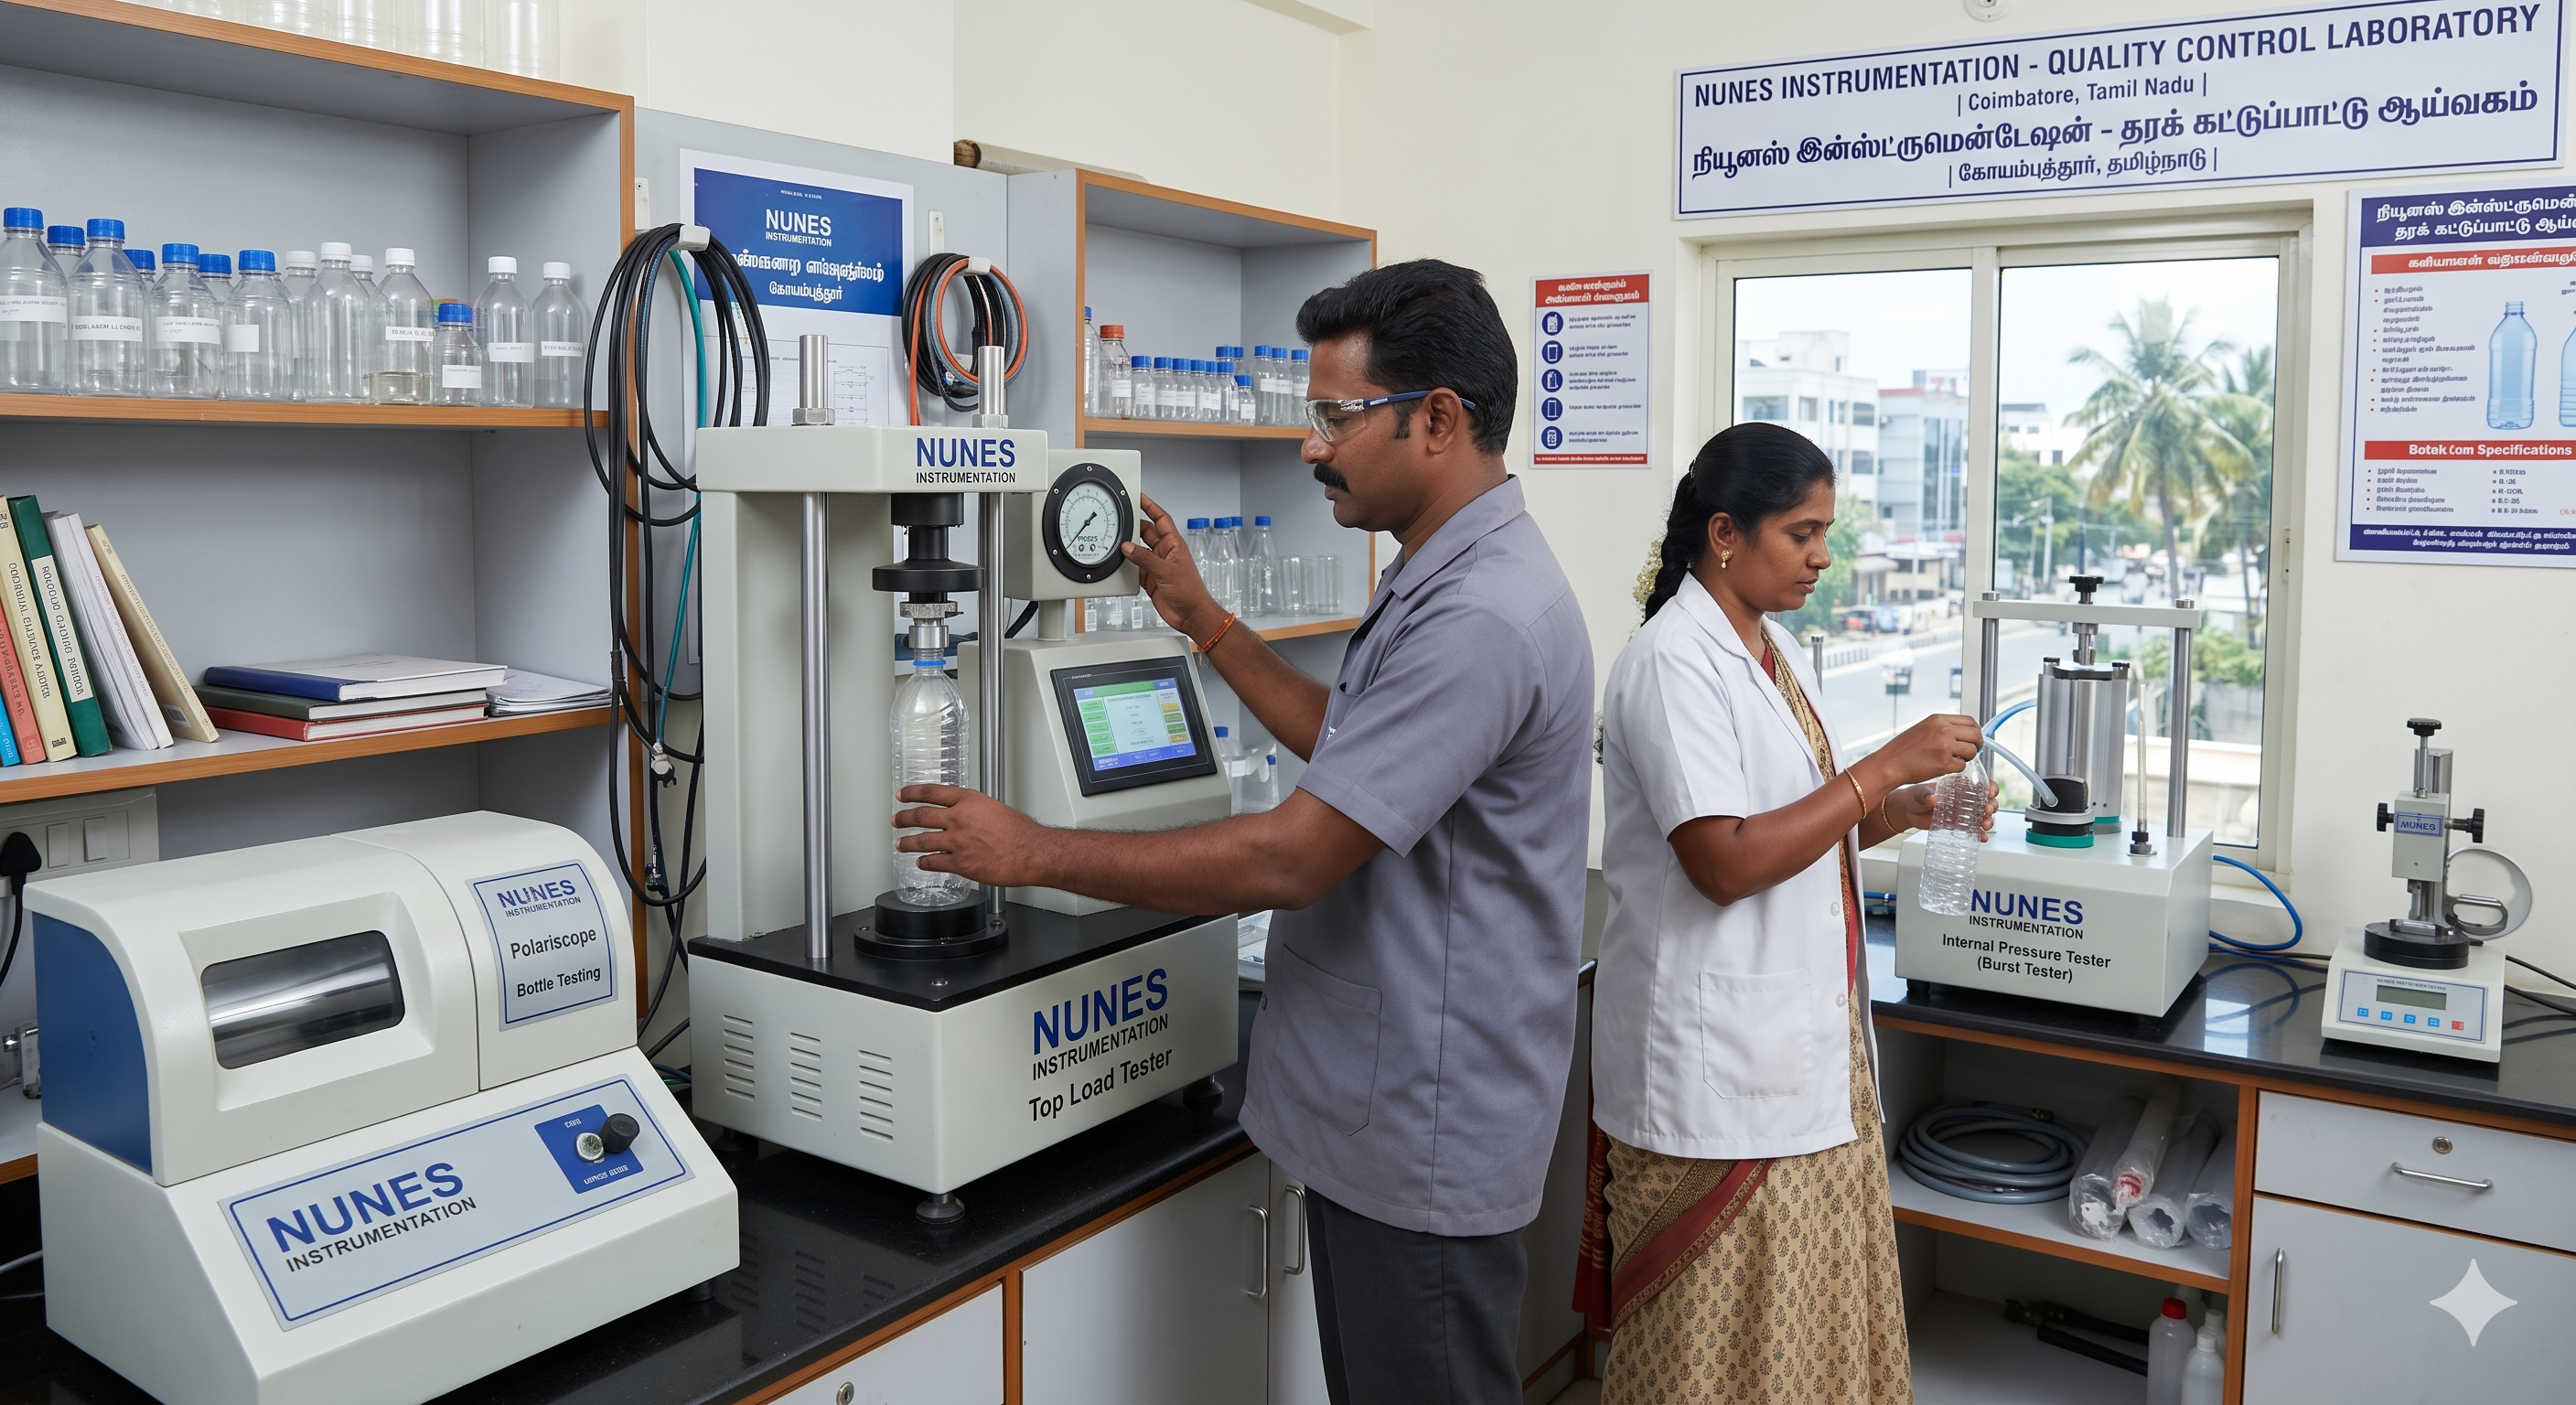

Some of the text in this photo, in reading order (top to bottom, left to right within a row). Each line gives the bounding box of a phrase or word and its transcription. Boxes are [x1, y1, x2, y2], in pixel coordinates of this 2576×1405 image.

[1694, 79, 1773, 107] NUNES
[1781, 54, 2020, 99] INSTRUMENTATION
[2048, 40, 2166, 76] QUALITY
[2176, 26, 2316, 63] CONTROL
[2327, 4, 2541, 49] LABORATORY
[1968, 88, 2080, 111] Coimbatore,
[2087, 79, 2137, 102] Tamil
[2144, 77, 2195, 94] Nadu
[1691, 140, 1790, 181] நியூனஸ்
[2120, 108, 2184, 151] தரக்
[2194, 96, 2368, 137] கட்டுப்பாட்டு
[2377, 80, 2538, 125] ஆய்வகம்
[2107, 147, 2207, 178] தமிழ்நாடு
[766, 209, 832, 237] NUNES
[2377, 201, 2444, 222] நியூனஸ்
[2394, 222, 2431, 241] தரக்
[2434, 218, 2531, 237] கட்டுப்பாட்டு
[916, 437, 1016, 468] NUNES
[2477, 444, 2572, 457] Specifications
[916, 471, 1016, 484] INSTRUMENTATION
[497, 879, 576, 908] NUNES
[505, 896, 582, 917] INSTRUMENTATION
[1970, 888, 2084, 925] NUNES
[1969, 915, 2084, 940] INSTRUMENTATION
[510, 928, 596, 960] Polariscope
[1942, 933, 2111, 969] Internal Pressure Tester
[517, 967, 601, 998] Bottle Testing
[1977, 956, 2073, 984] (Burst Tester)
[1033, 968, 1168, 1056] NUNES
[1033, 1013, 1168, 1081] INSTRUMENTATION
[1028, 1048, 1173, 1121] Top Load Tester
[265, 1161, 464, 1253] NUNES
[284, 1196, 478, 1273] INSTRUMENTATION
